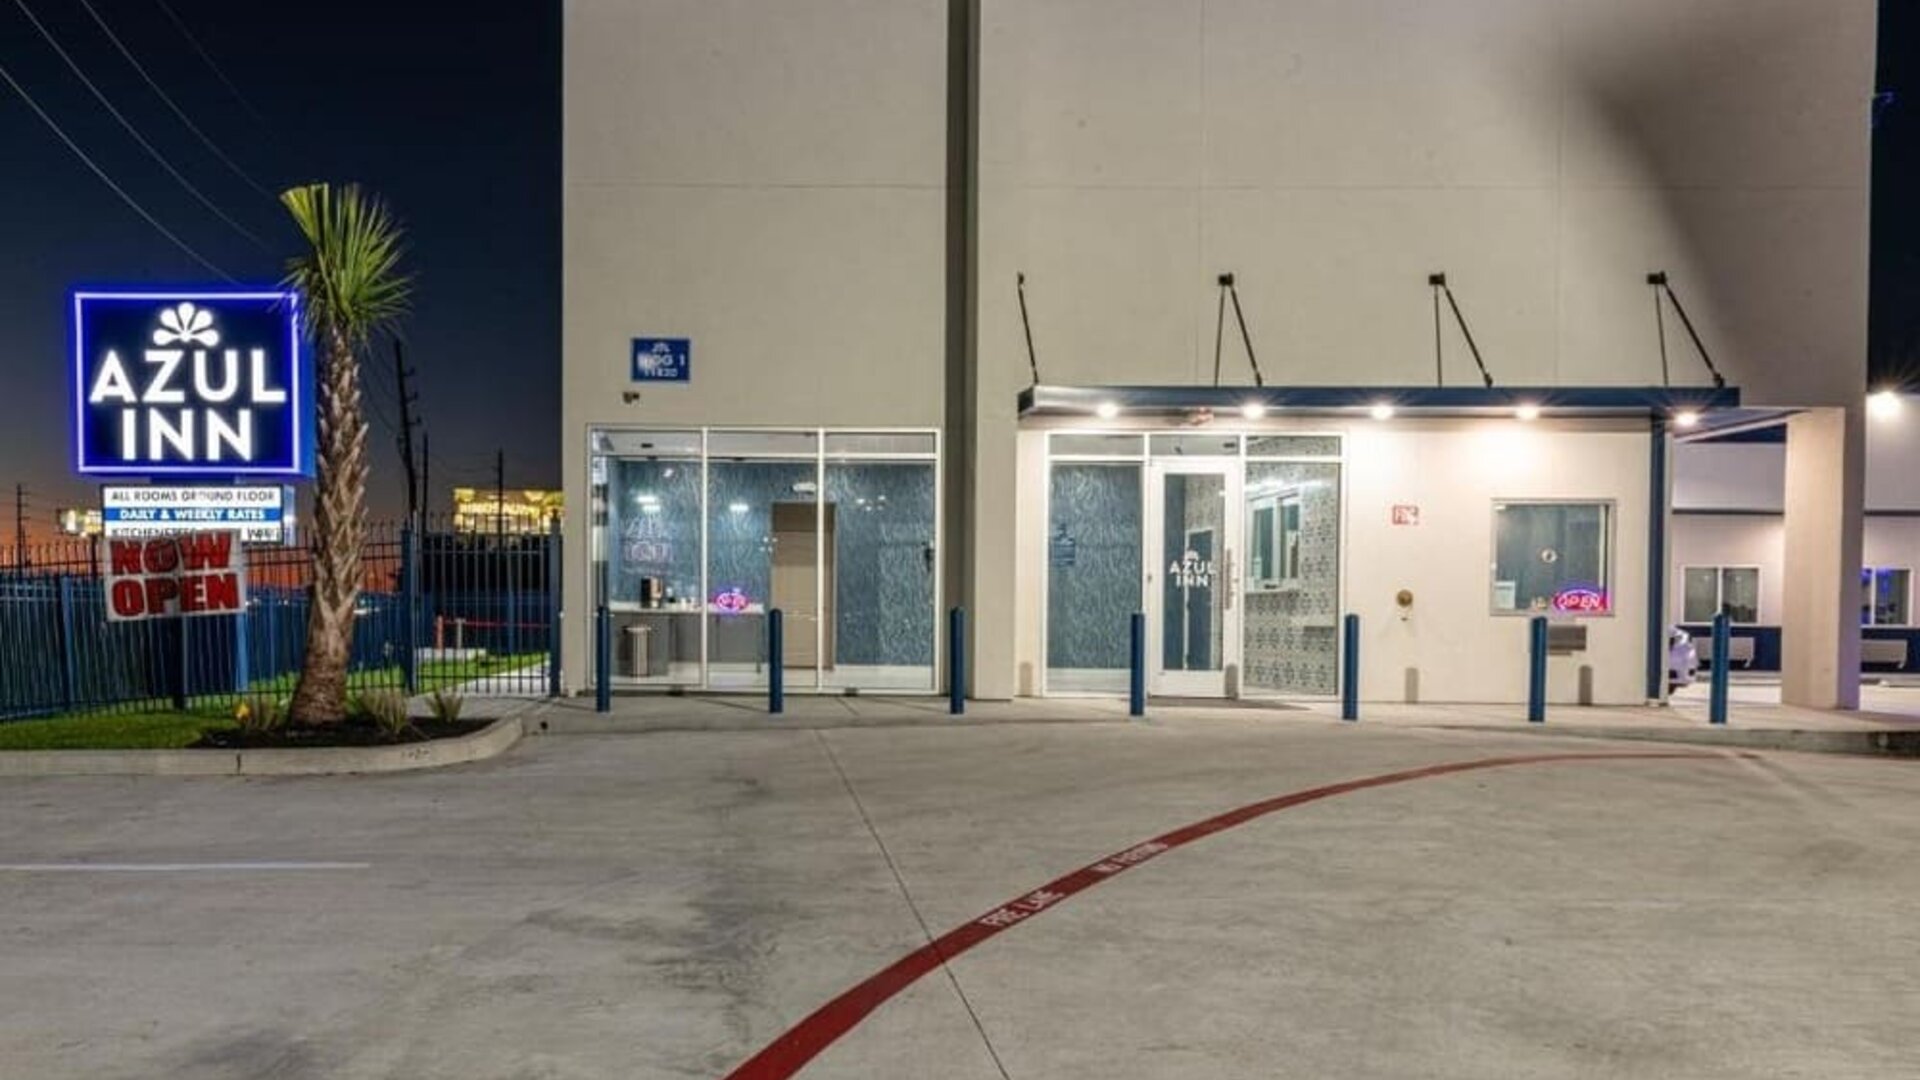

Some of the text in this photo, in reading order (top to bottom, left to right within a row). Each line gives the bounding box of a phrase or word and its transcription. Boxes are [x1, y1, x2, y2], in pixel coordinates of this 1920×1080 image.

[89, 349, 286, 403] AZUL
[122, 408, 252, 461] INN
[111, 490, 275, 501] ALL ROOMS GROUND FLOOR
[120, 509, 155, 520] DAILY
[175, 509, 221, 520] WEEKLY
[228, 509, 265, 520] RATES
[109, 531, 232, 576] NOW
[1169, 560, 1217, 574] AZUL
[1175, 575, 1209, 588] INN
[111, 573, 240, 617] OPEN
[1556, 594, 1601, 609] OPEN
